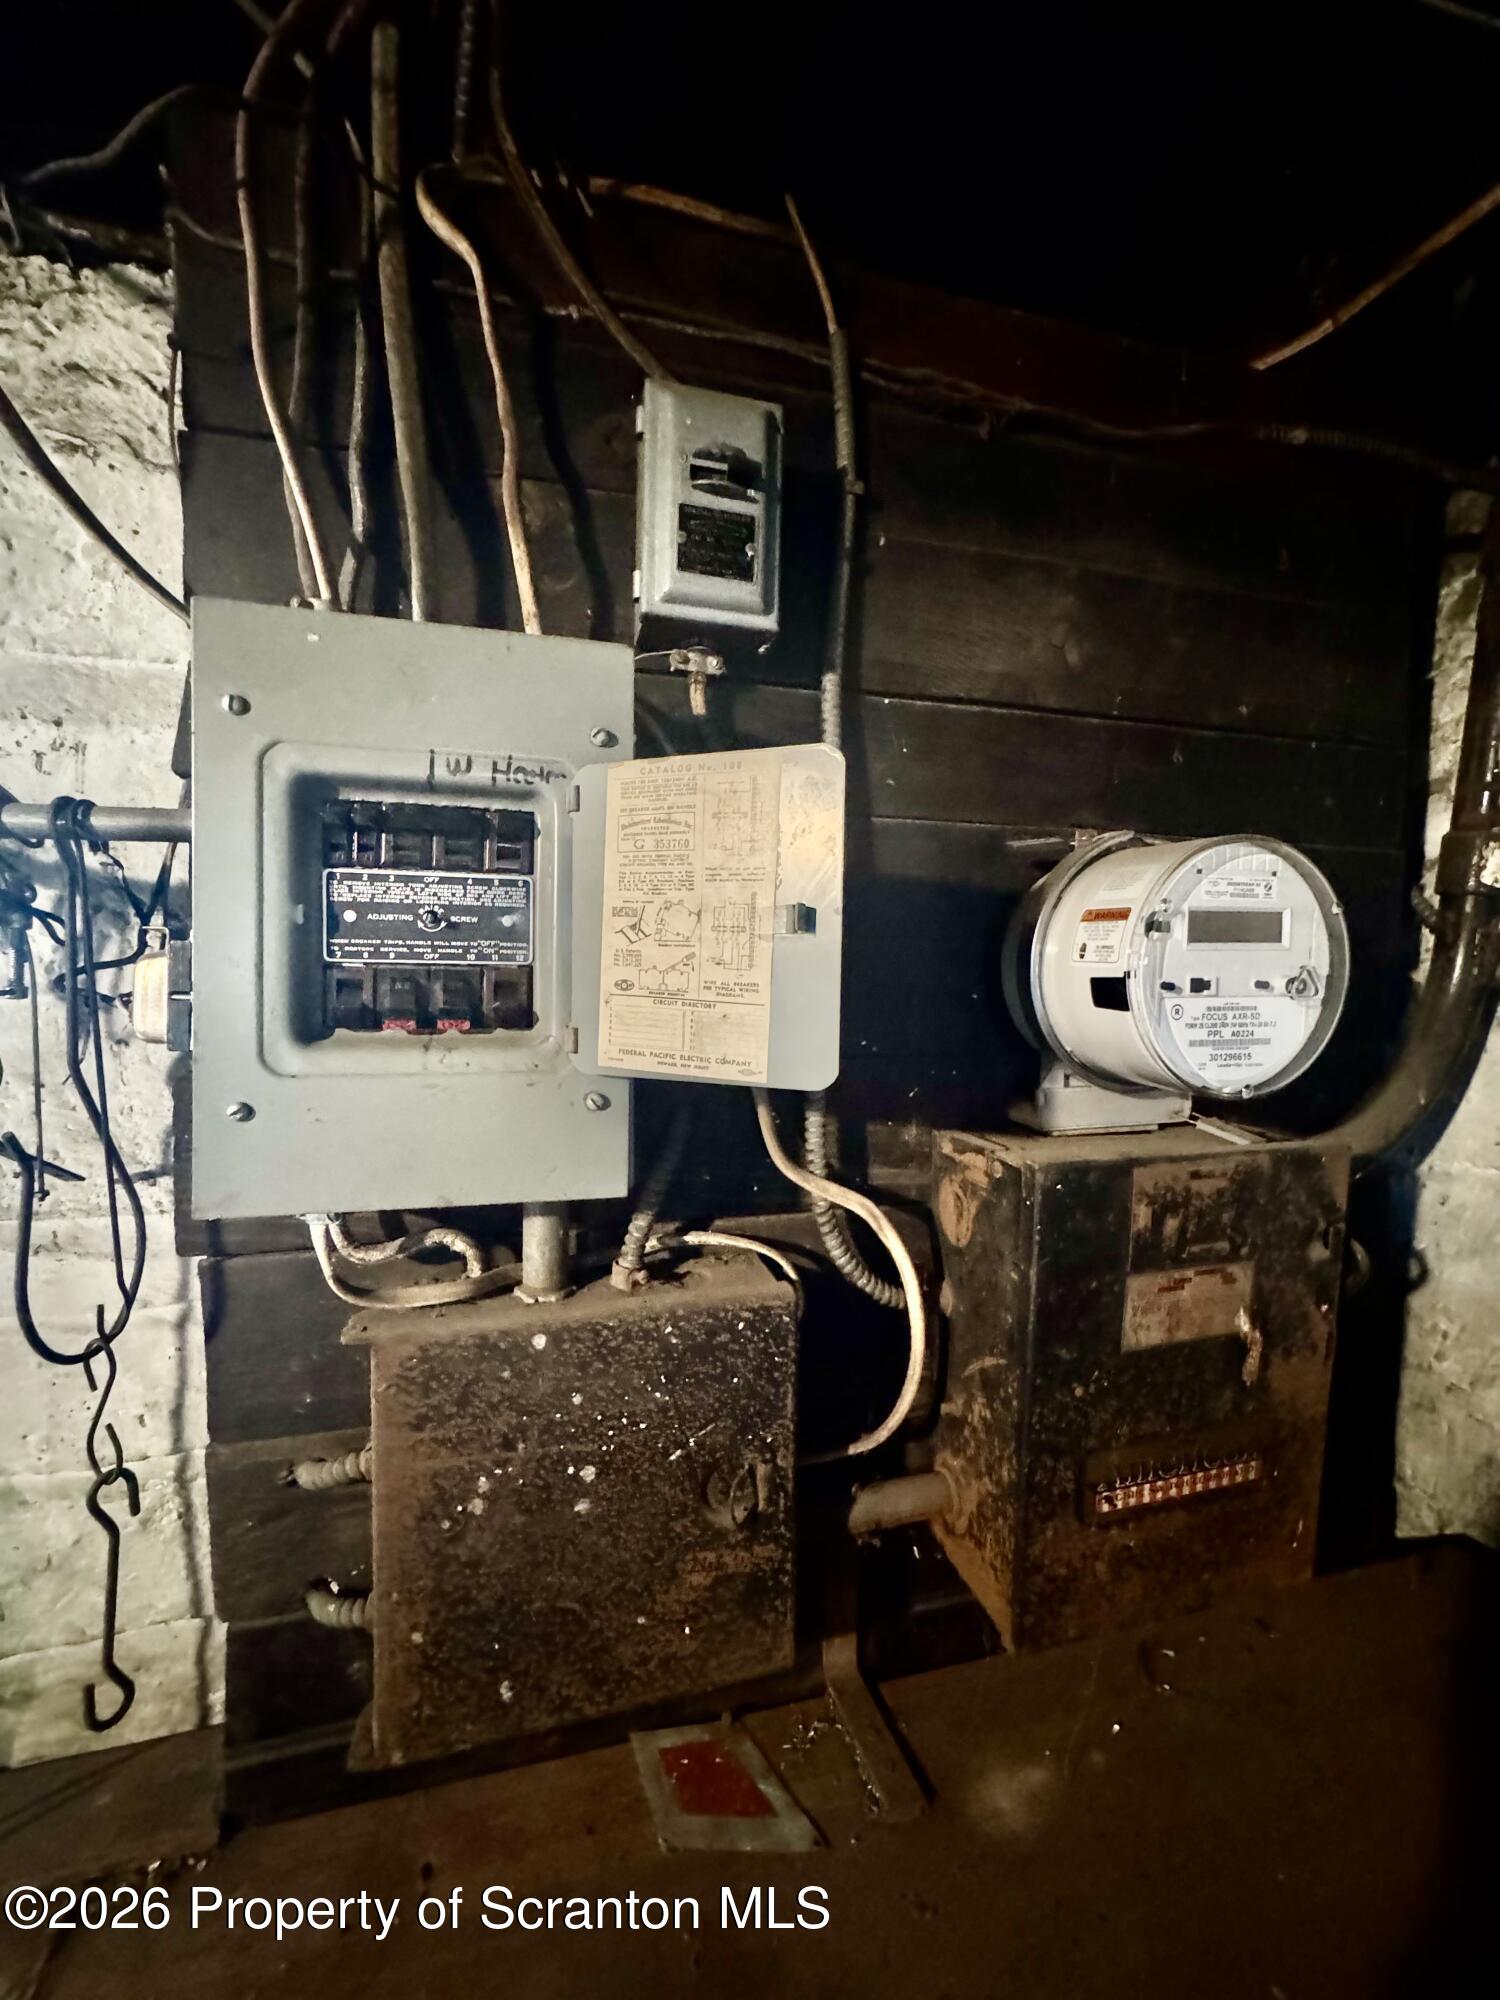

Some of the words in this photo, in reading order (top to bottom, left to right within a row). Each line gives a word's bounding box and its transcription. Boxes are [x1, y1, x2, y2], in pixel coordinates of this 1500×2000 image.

[640, 764, 692, 776] CATALOG
[634, 839, 645, 849] G
[653, 838, 690, 849] 353760
[367, 913, 414, 921] ADJUSTING
[682, 1001, 717, 1009] DIRECTORY
[1201, 1013, 1228, 1021] FOCUS
[1207, 1030, 1224, 1038] PPL
[1231, 1030, 1254, 1038] A0224
[618, 1049, 646, 1057] FEDERAL
[650, 1051, 676, 1060] PACIFIC
[680, 1055, 711, 1064] ELECTRIC
[715, 1057, 752, 1067] COMPANY
[1208, 1052, 1252, 1062] 301296615
